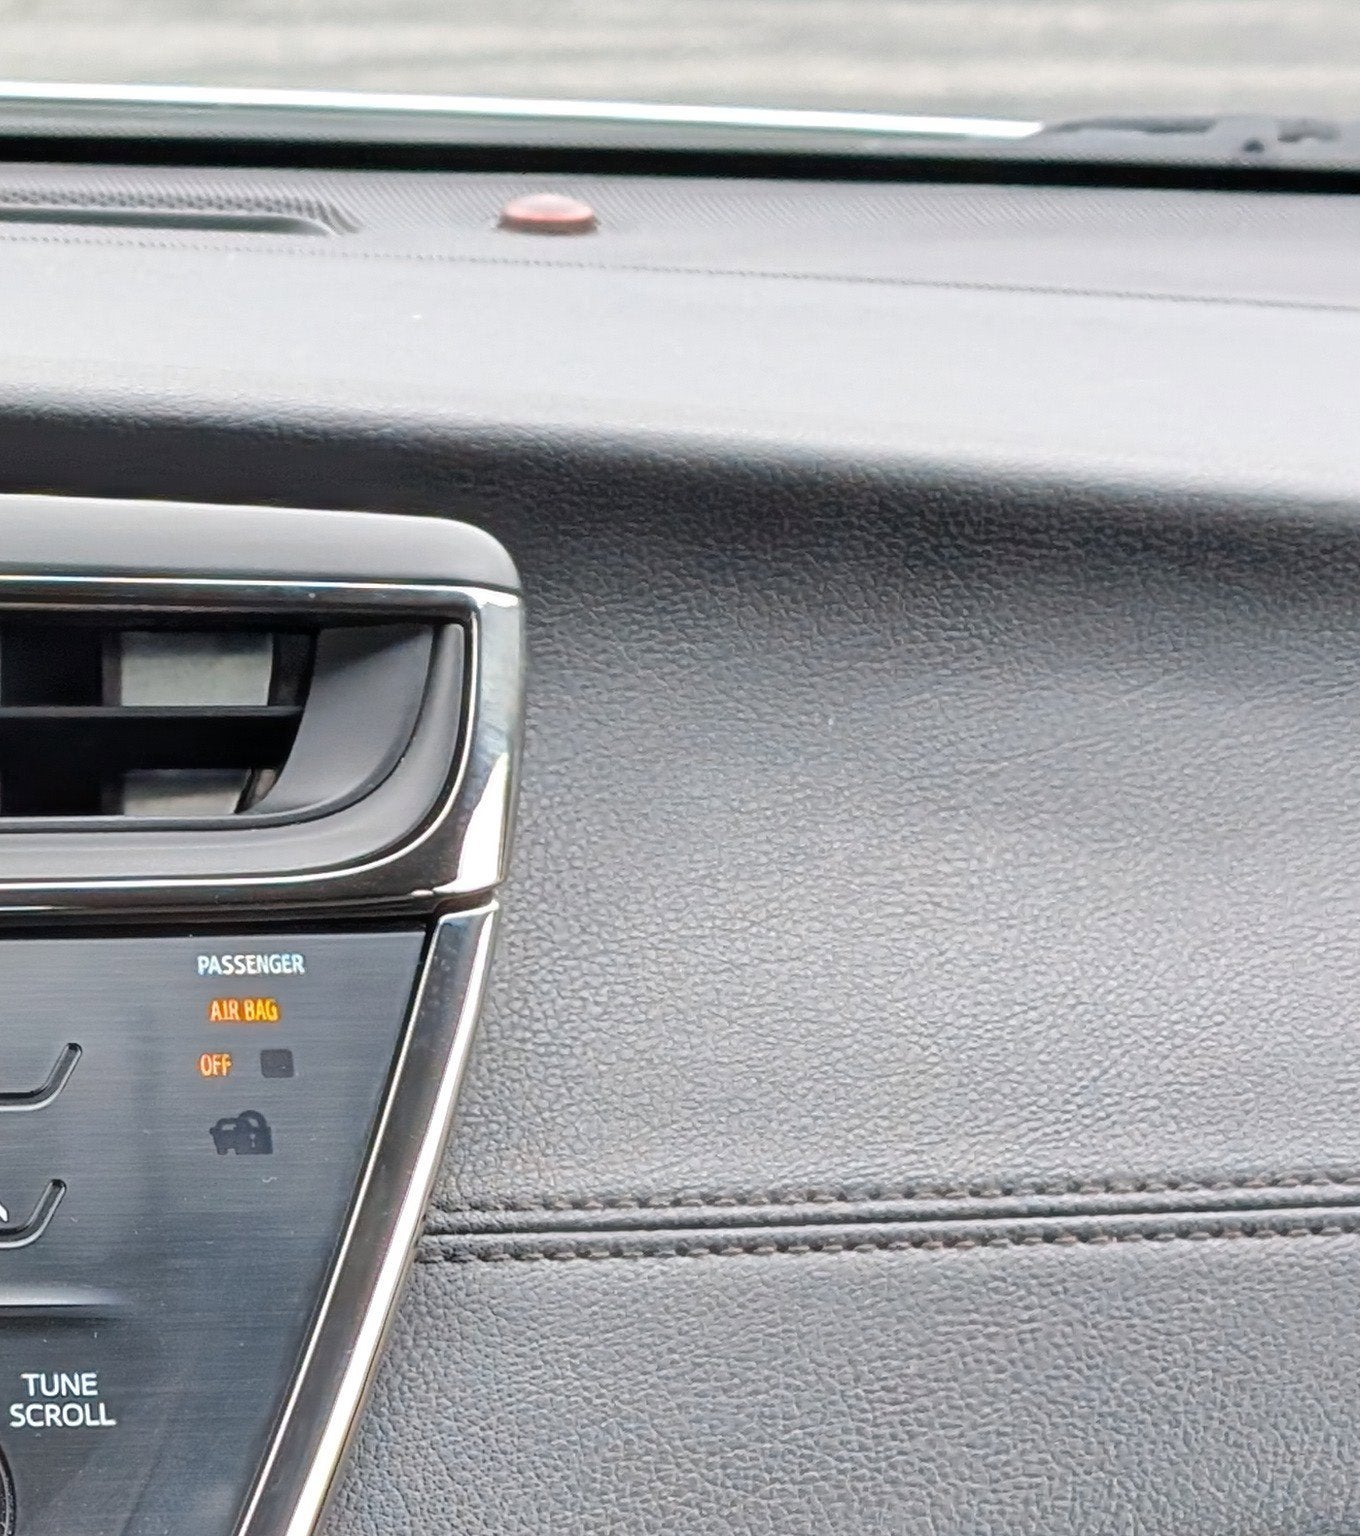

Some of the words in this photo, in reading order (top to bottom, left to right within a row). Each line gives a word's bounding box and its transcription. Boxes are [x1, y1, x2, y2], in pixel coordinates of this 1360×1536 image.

[196, 953, 306, 976] PASSENGER
[210, 999, 239, 1022] AIR
[244, 998, 279, 1022] BAG
[199, 1053, 232, 1077] OFF
[20, 1372, 100, 1398] TUNE
[8, 1402, 118, 1428] SCROLL
